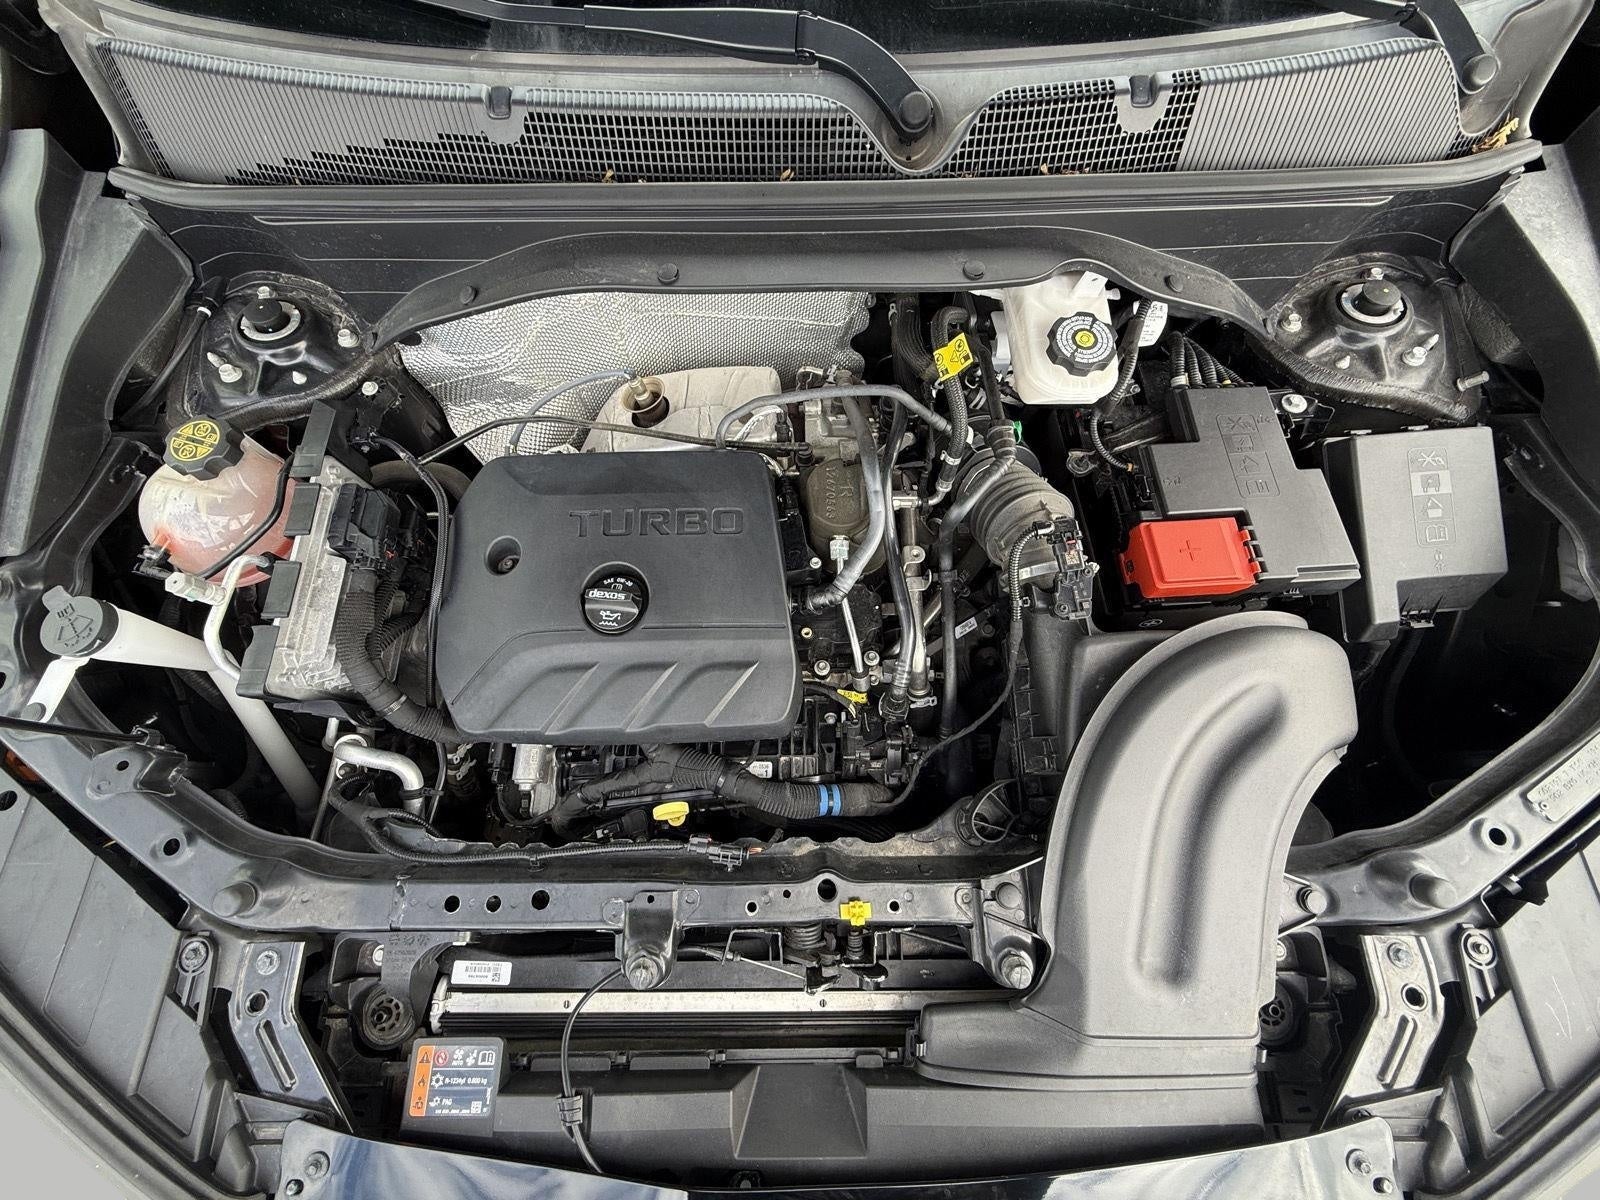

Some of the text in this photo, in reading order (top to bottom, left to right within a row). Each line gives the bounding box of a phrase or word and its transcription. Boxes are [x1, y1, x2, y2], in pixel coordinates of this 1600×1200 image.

[569, 506, 744, 538] TURBO
[603, 577, 615, 585] SAE
[588, 588, 627, 601] dexos
